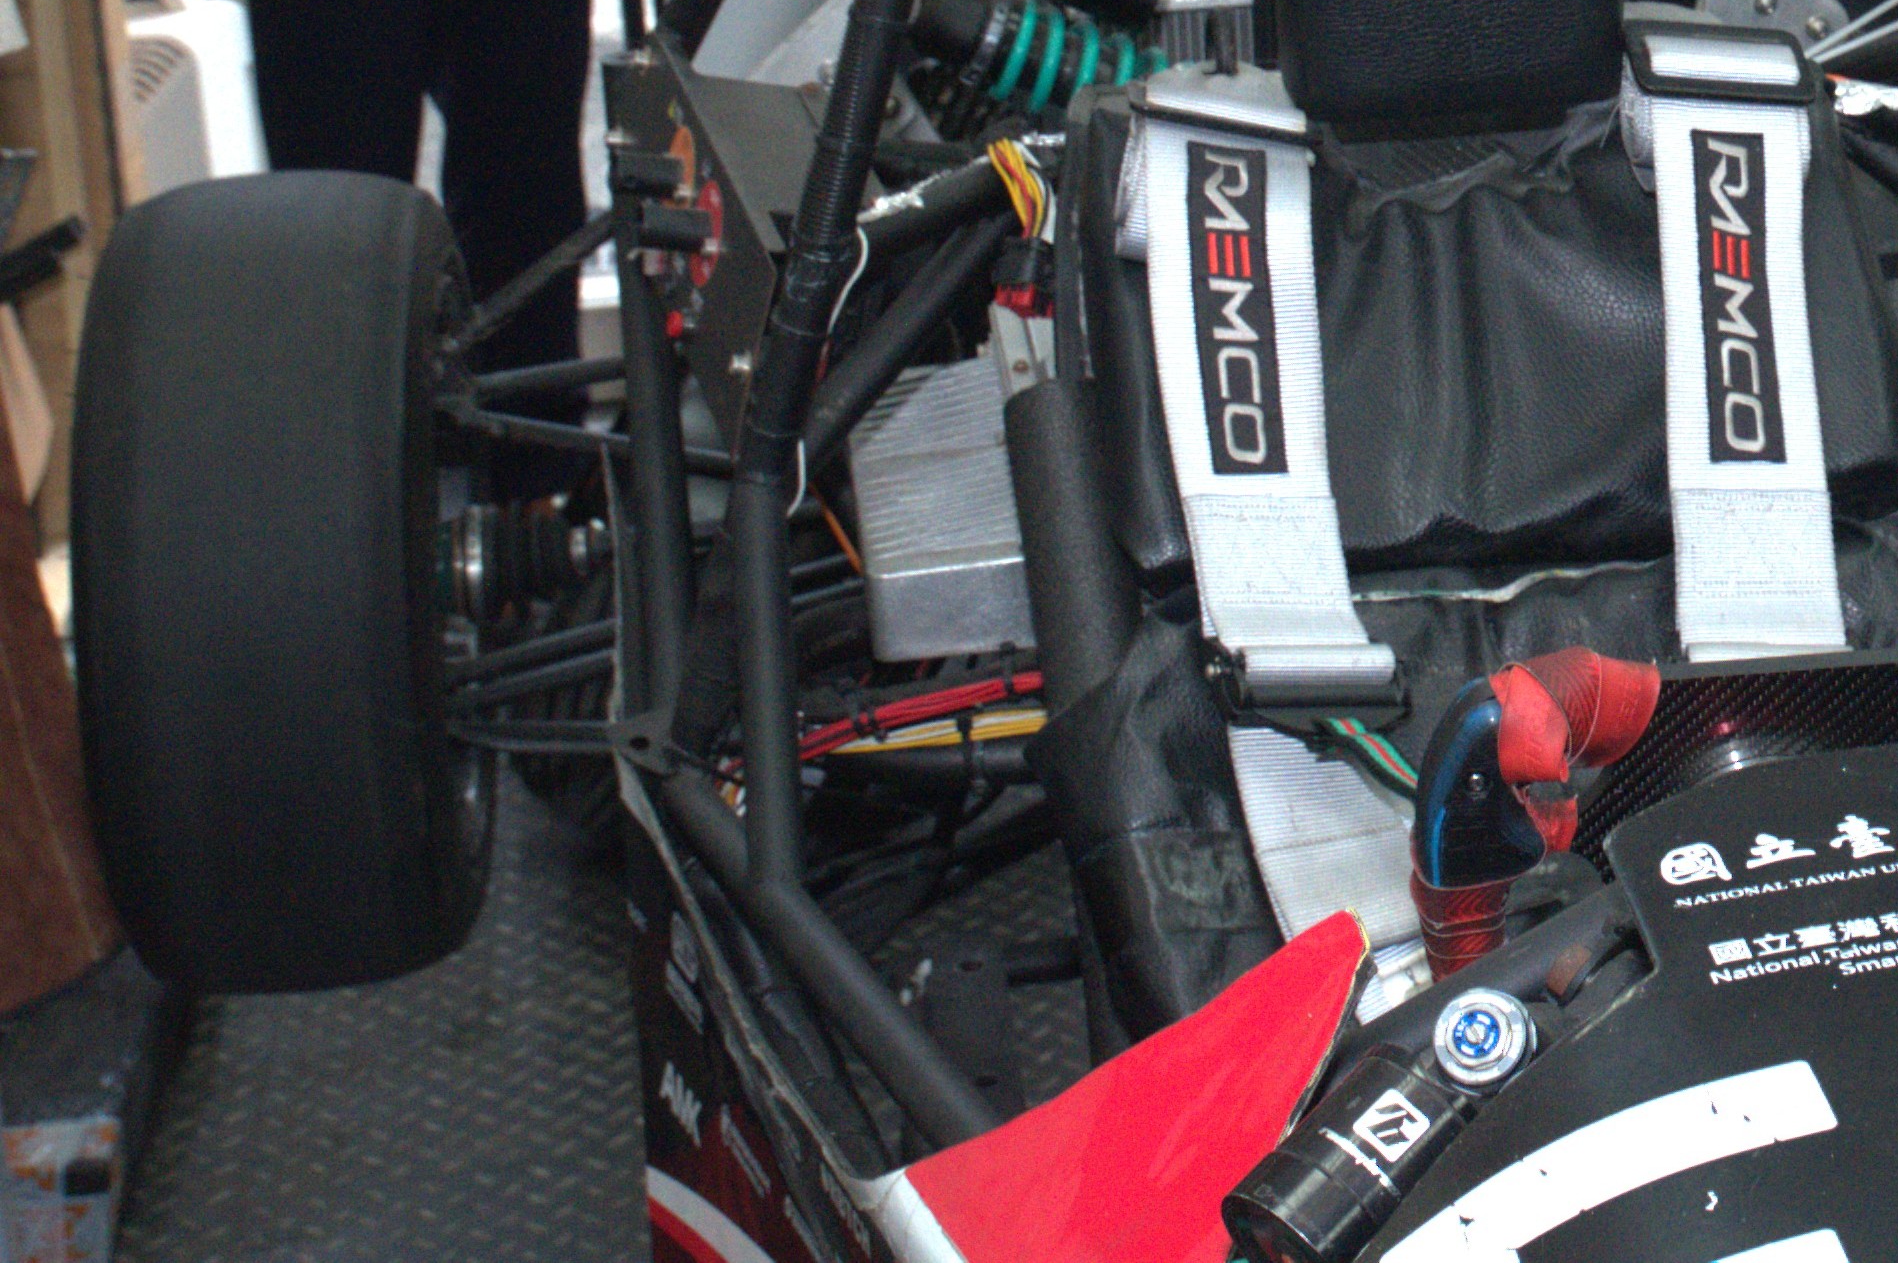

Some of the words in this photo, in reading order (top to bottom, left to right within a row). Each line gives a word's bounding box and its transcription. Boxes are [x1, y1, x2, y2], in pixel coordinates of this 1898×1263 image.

[1673, 881, 1789, 908] NATIONAL
[1789, 866, 1877, 888] TAIWAN
[1709, 949, 1822, 985] National
